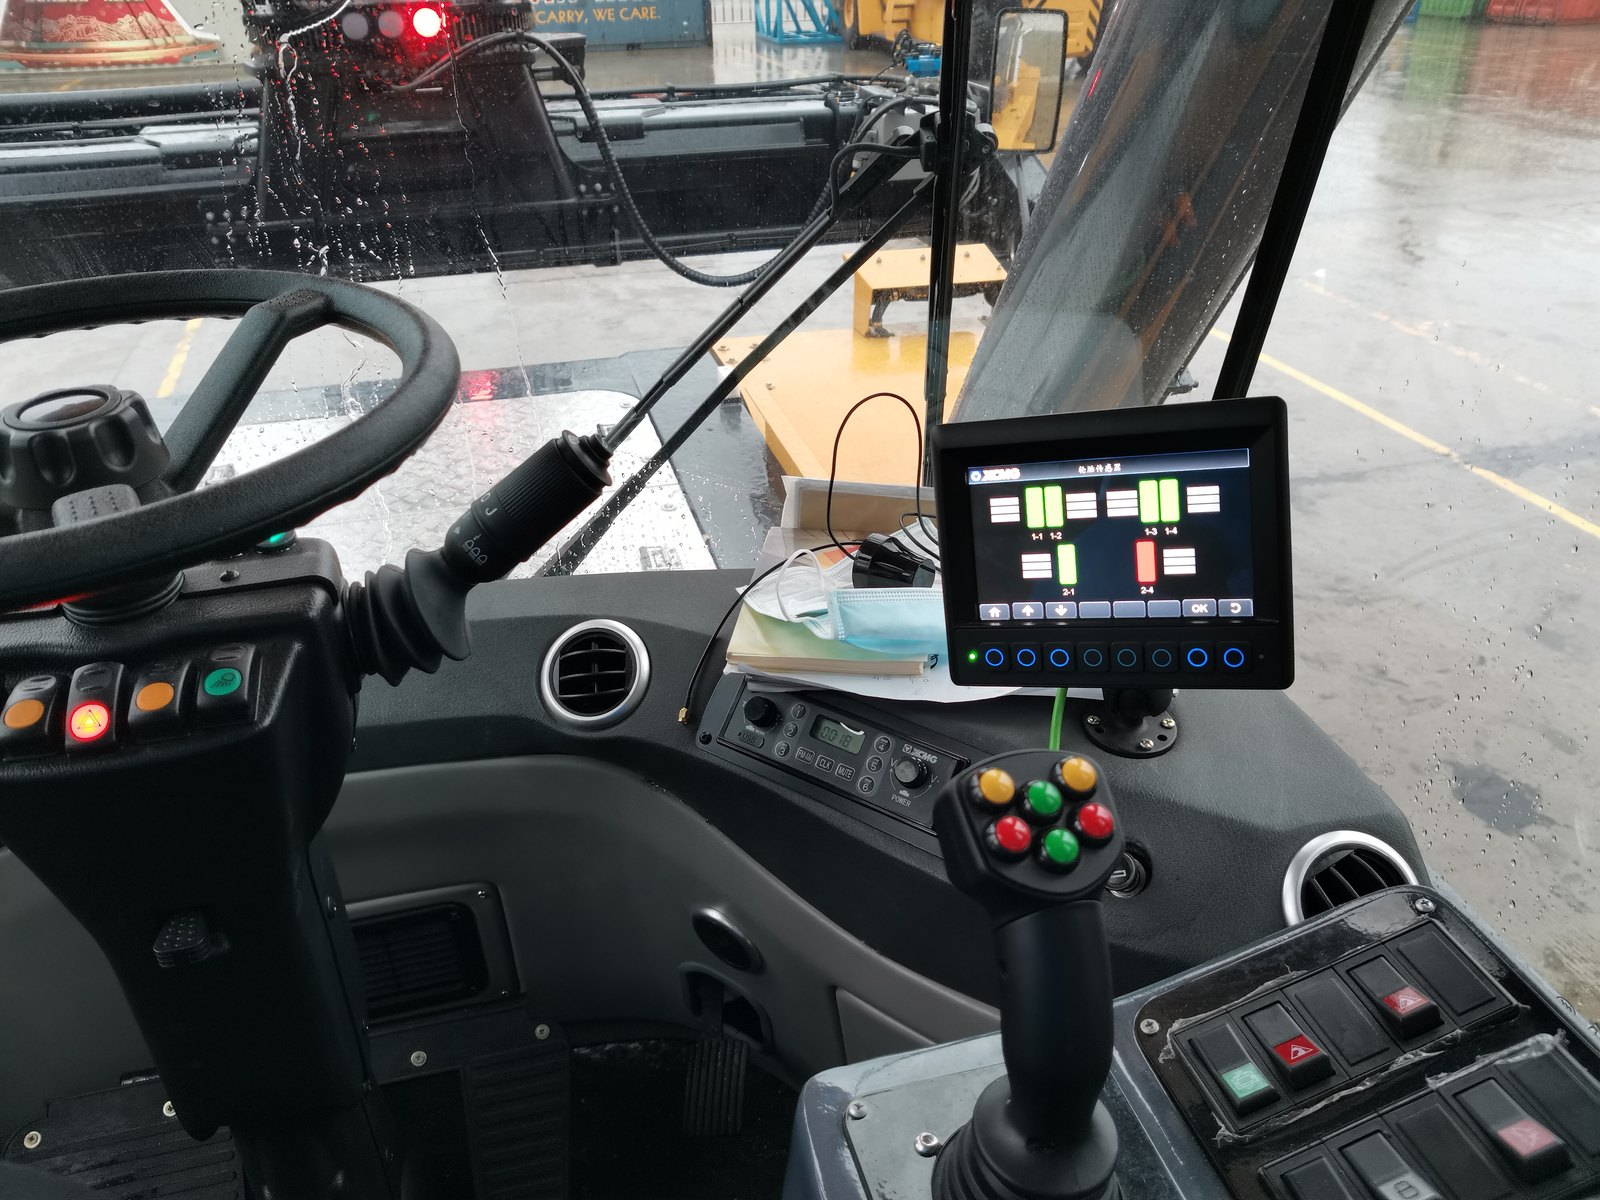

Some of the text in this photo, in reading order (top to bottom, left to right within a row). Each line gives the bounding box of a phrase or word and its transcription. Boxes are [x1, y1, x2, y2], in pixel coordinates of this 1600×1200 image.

[534, 9, 588, 24] CARRY,
[593, 8, 615, 21] WE
[1165, 527, 1177, 535] 1-4
[1062, 586, 1154, 596] 2-1 2-4
[1191, 603, 1208, 613] OK
[819, 758, 832, 770] CLK
[839, 765, 853, 779] MUTE
[891, 793, 912, 807] POWER
